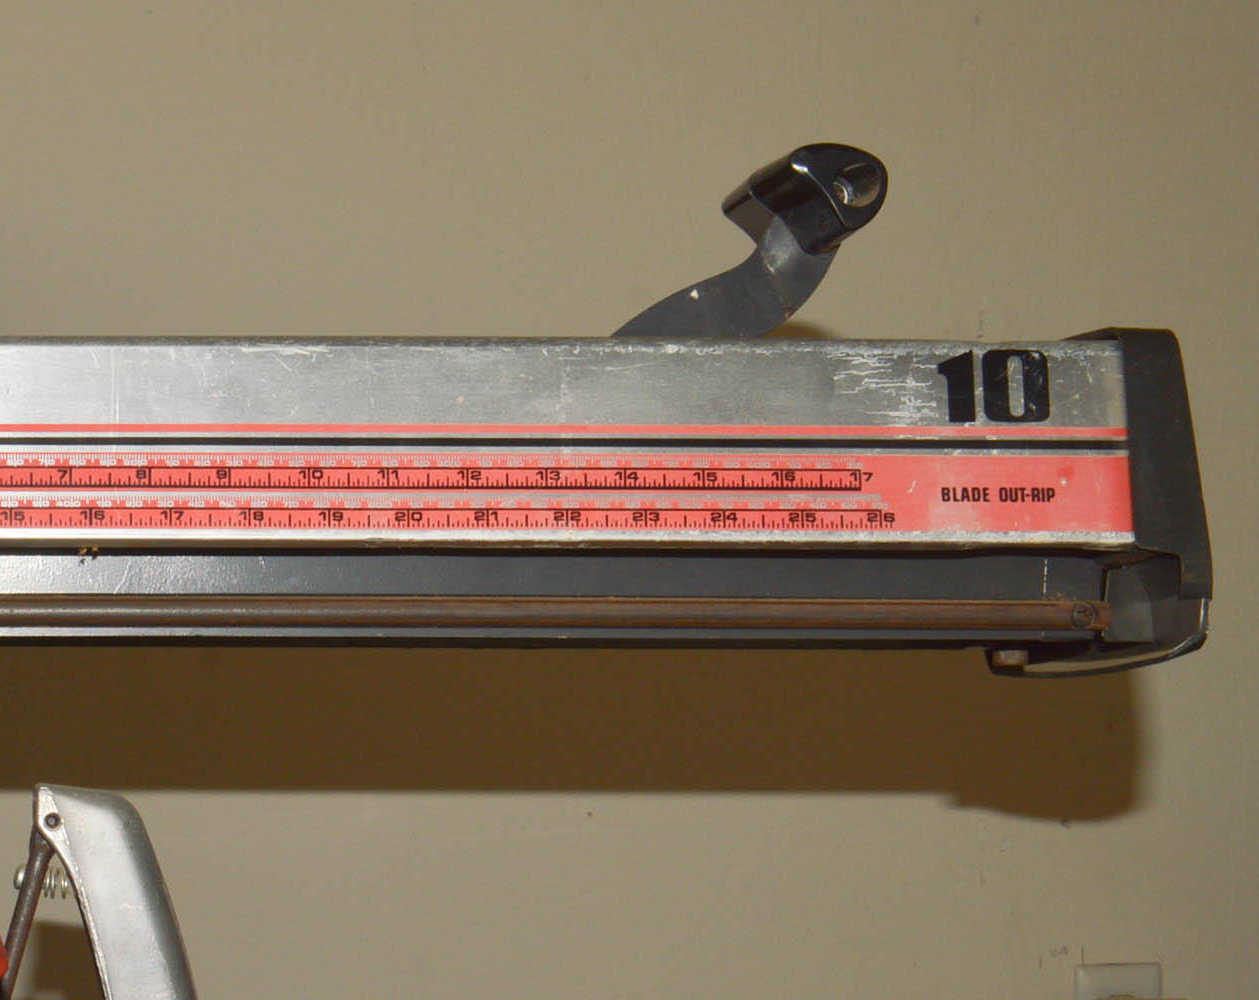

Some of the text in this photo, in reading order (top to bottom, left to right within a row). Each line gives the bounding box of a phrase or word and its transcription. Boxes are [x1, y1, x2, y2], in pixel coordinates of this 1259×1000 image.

[938, 350, 1050, 423] 10
[58, 469, 68, 479] 7
[136, 469, 147, 479] 8
[216, 469, 227, 479] 9
[941, 487, 1055, 502] BLADE OUT-RIP
